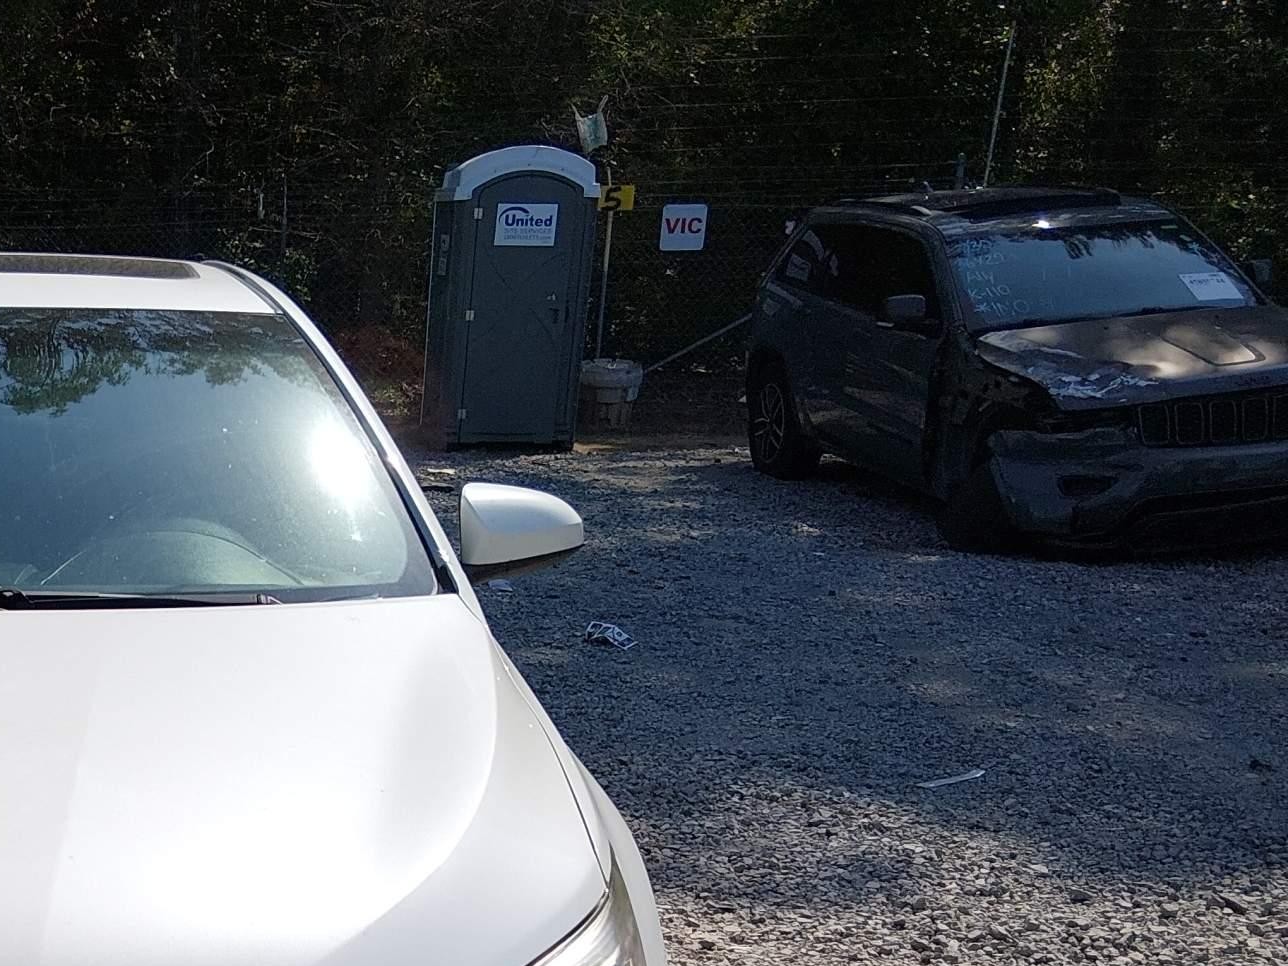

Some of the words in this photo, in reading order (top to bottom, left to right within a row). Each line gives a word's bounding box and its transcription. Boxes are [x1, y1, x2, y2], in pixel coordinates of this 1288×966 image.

[601, 186, 622, 211] 5
[504, 213, 553, 227] United
[665, 217, 703, 234] VIC
